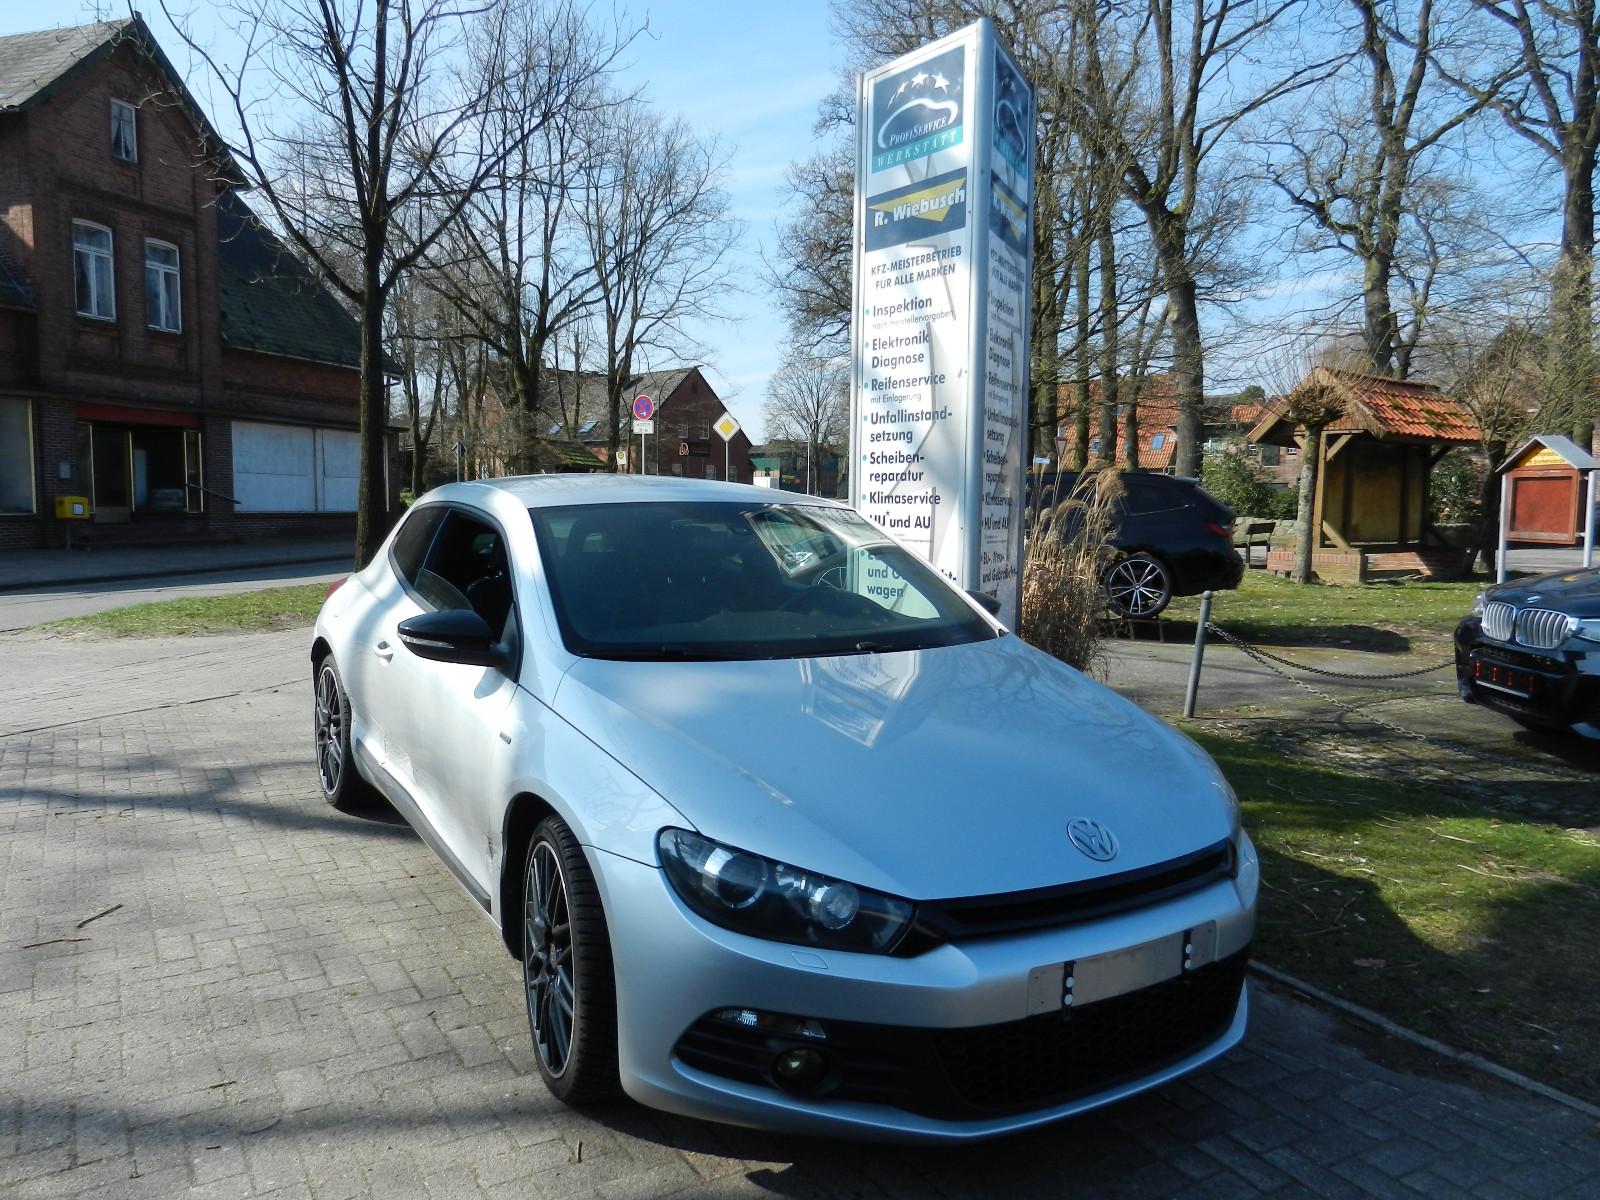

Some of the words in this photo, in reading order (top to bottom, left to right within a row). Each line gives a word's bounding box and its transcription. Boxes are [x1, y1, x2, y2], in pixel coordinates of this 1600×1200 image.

[877, 130, 958, 168] WERKSTATT
[874, 209, 889, 228] R.
[893, 188, 965, 222] Wiebusch
[871, 245, 962, 276] KFZ-MEISTERBETRIEB
[894, 271, 915, 287] ALLE
[916, 263, 956, 283] MARKEN
[873, 296, 932, 318] Inspektion
[872, 330, 930, 351] Elektronik
[871, 352, 925, 370] Diagnose
[871, 372, 946, 392] Reifenservice
[870, 394, 881, 404] mit
[870, 405, 953, 425] Unfallinstand-
[870, 430, 913, 445] setzung
[869, 452, 925, 465] Scheiben-
[869, 470, 924, 483] reparatur
[869, 491, 941, 505] Klimaservice
[889, 514, 911, 529] und
[914, 516, 931, 529] AU
[867, 565, 888, 579] und
[867, 583, 904, 599] wagen
